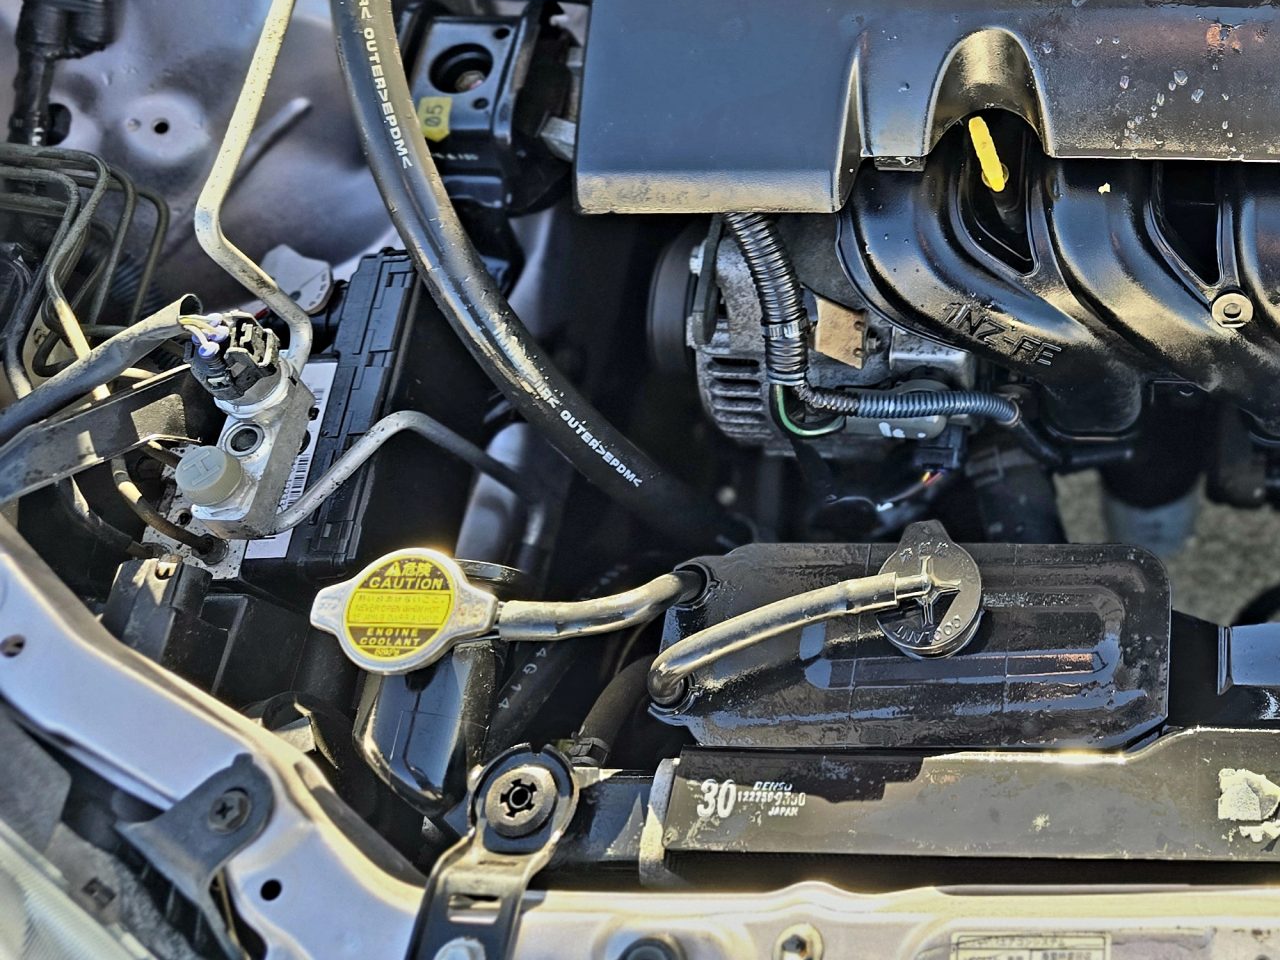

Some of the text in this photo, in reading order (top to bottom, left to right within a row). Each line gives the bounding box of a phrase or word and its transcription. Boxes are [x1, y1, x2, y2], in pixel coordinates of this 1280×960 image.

[363, 26, 414, 170] OUTER>EPDM<
[559, 409, 643, 488] OUTER>EPDM<
[369, 576, 443, 590] CAUTION
[366, 628, 418, 637] ENGINE
[359, 637, 420, 646] COOLANT
[752, 781, 793, 791] DENSO
[696, 778, 736, 818] 30
[767, 806, 799, 817] JAPAN
